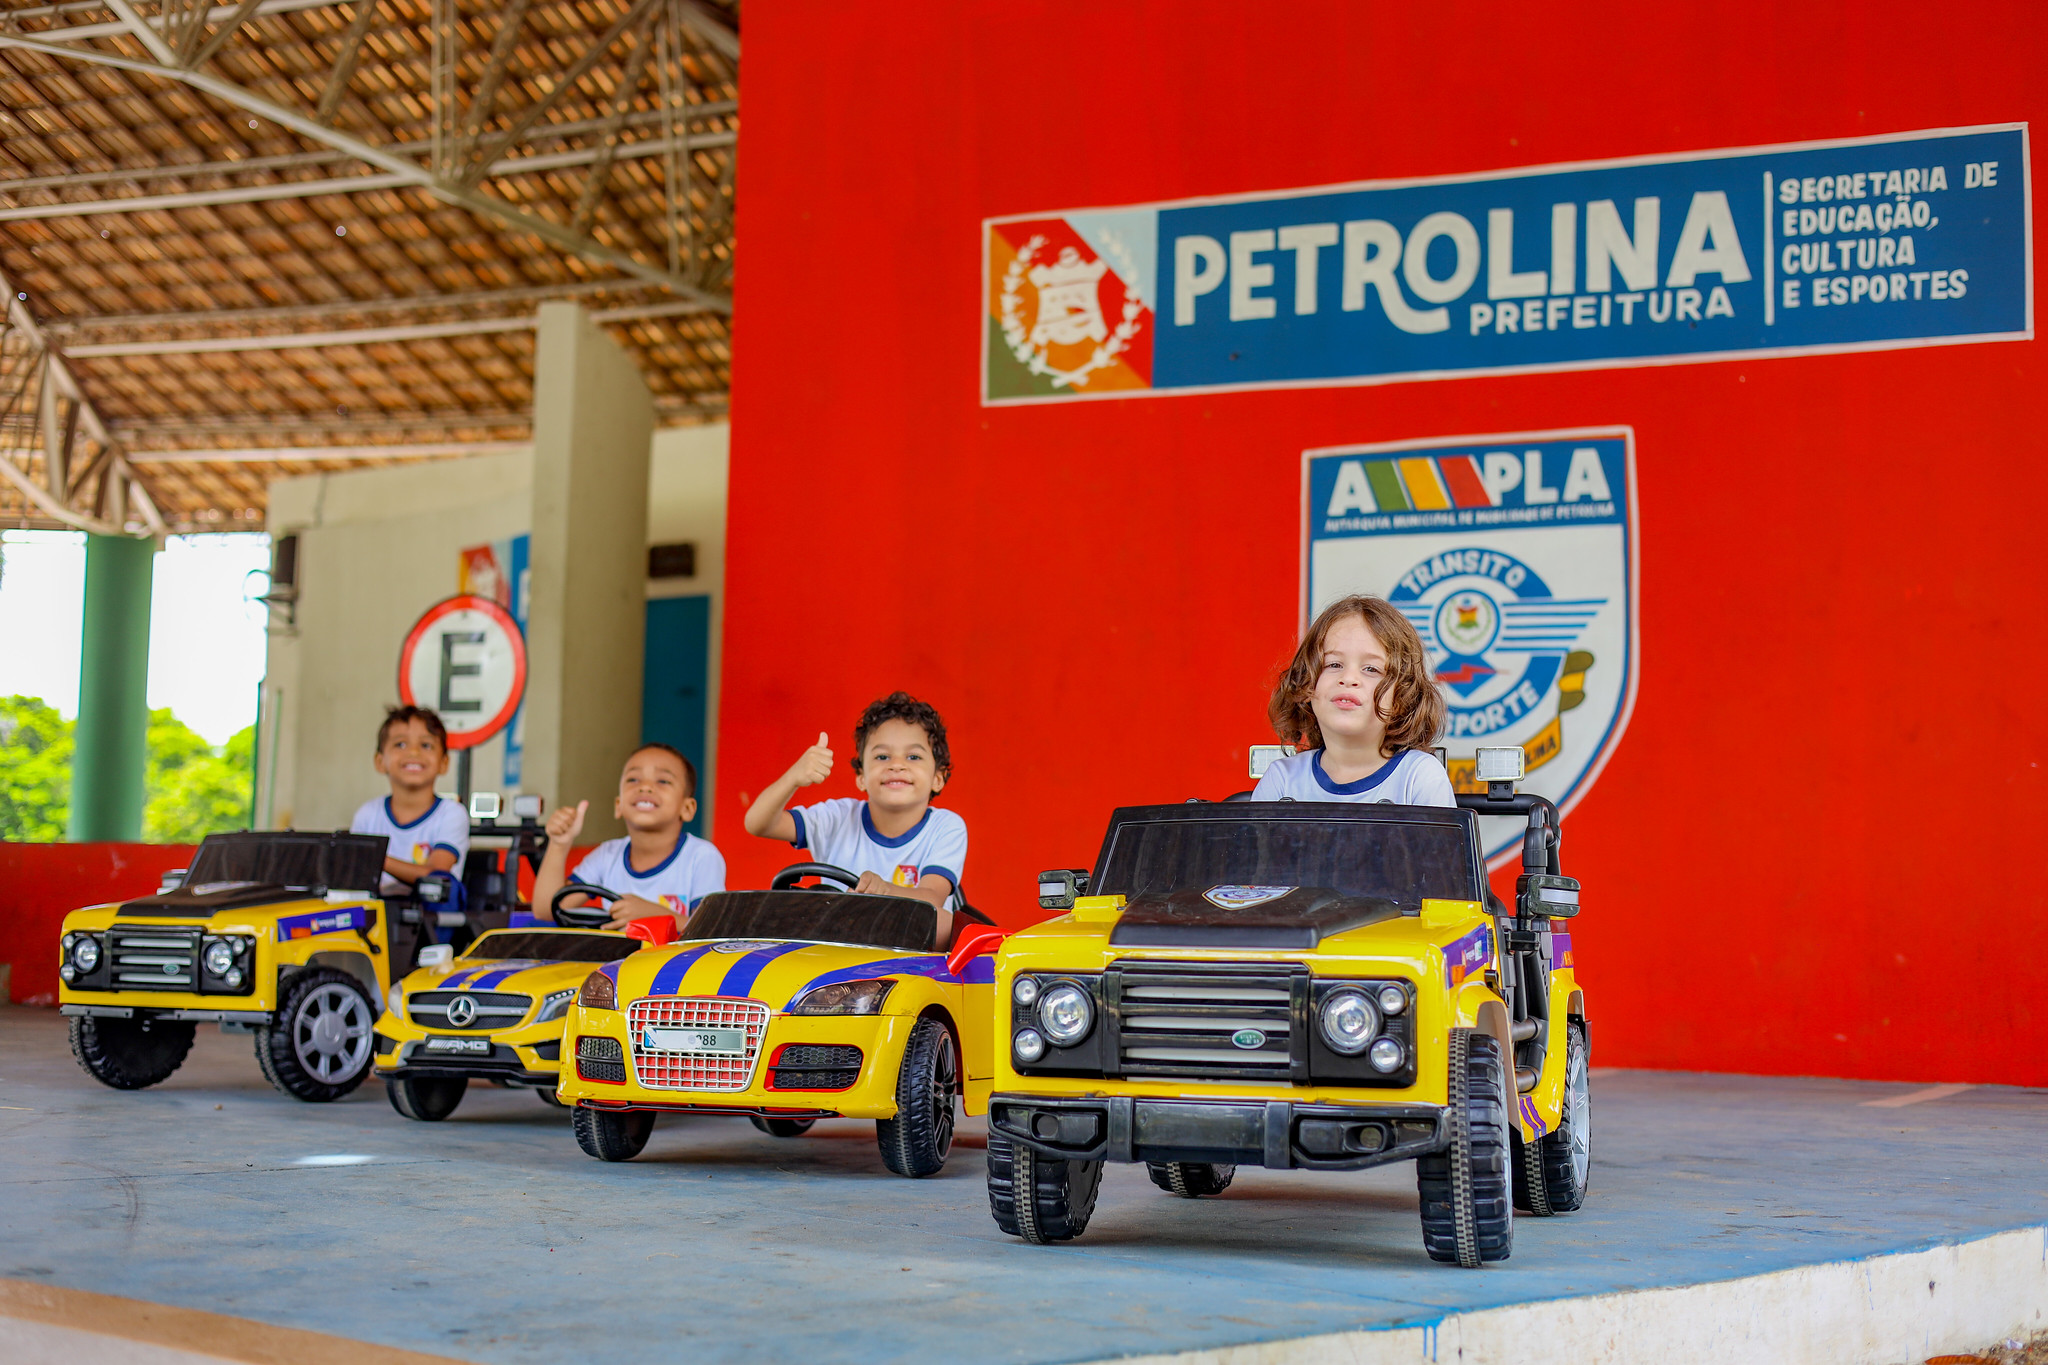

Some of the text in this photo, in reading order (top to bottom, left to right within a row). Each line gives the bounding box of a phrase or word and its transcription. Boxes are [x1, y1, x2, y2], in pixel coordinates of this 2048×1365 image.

[1779, 161, 1999, 204] SECRETARIA DE
[1783, 195, 1939, 236] EDUCAÇÃO,
[1174, 190, 1753, 334] PETROLINA
[1782, 235, 1916, 275] CULTURA
[1469, 286, 1735, 336] PREFEITURA
[1783, 269, 1969, 309] E ESPORTES
[439, 632, 486, 711] E
[1446, 680, 1541, 736] SPORTE
